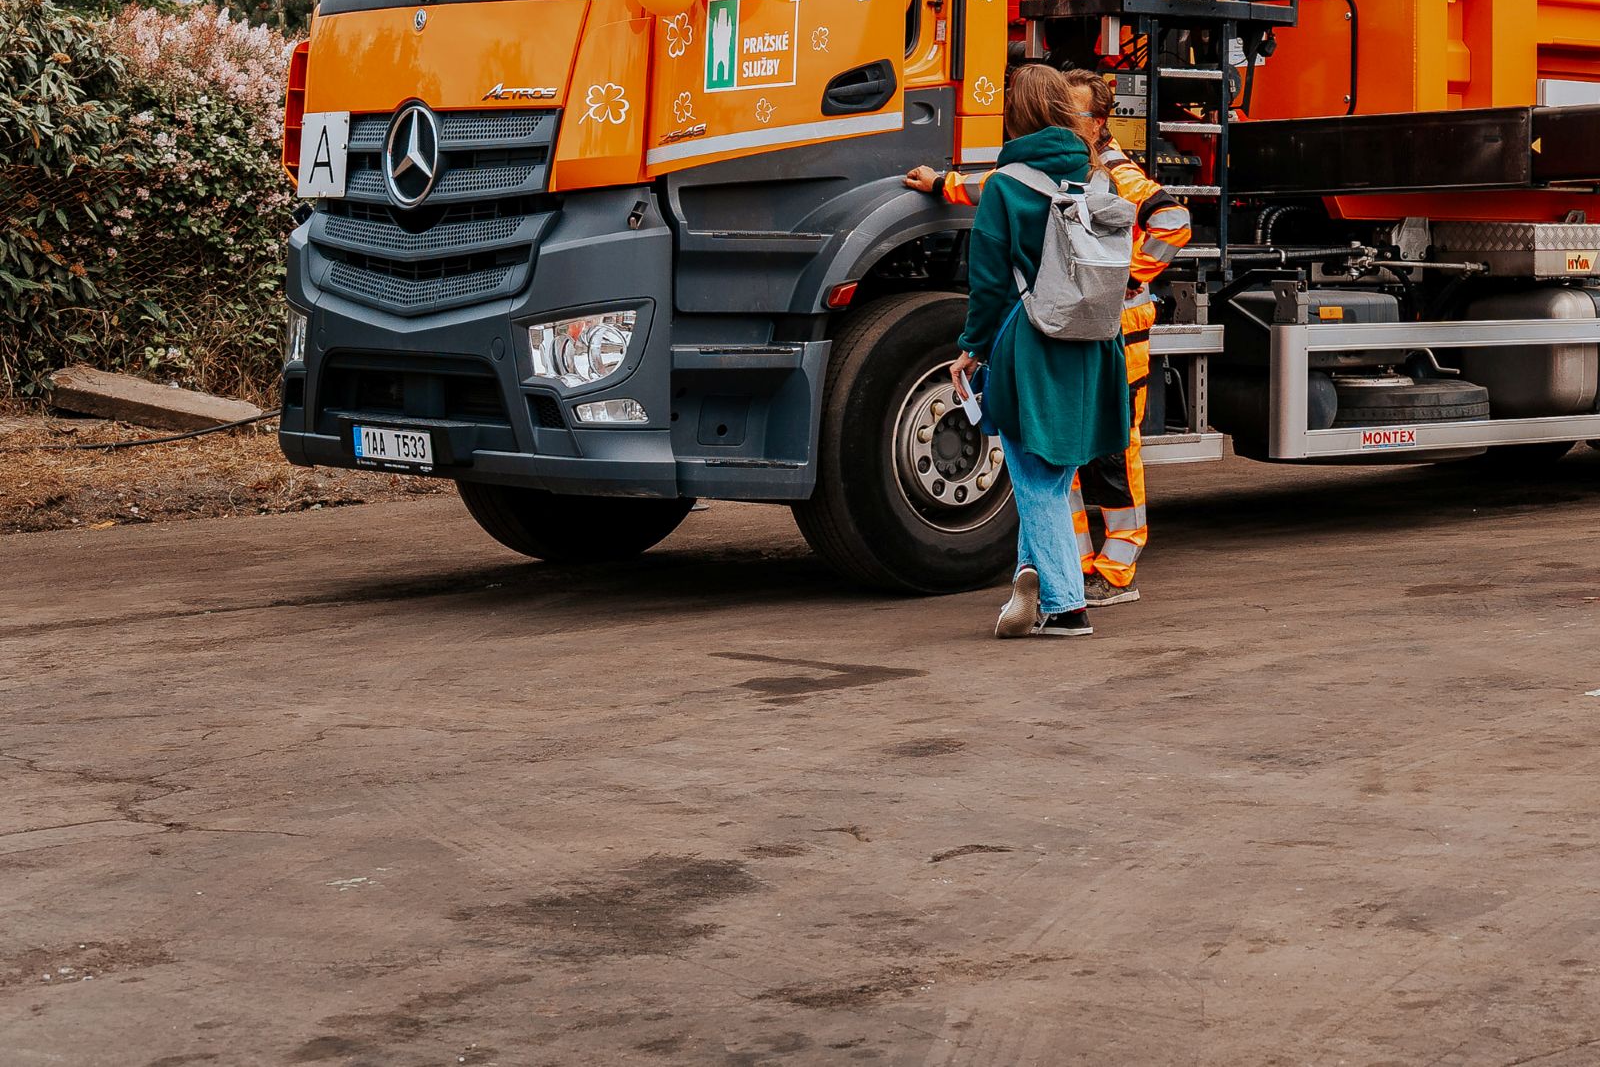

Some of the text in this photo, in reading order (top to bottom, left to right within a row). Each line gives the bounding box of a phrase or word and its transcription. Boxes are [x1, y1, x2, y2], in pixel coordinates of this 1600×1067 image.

[743, 31, 789, 54] PRAŽSKÉ
[742, 57, 780, 78] SLUŽBY
[308, 124, 334, 184] A
[364, 431, 426, 459] 1AA T533
[1362, 430, 1415, 445] MONTEX
